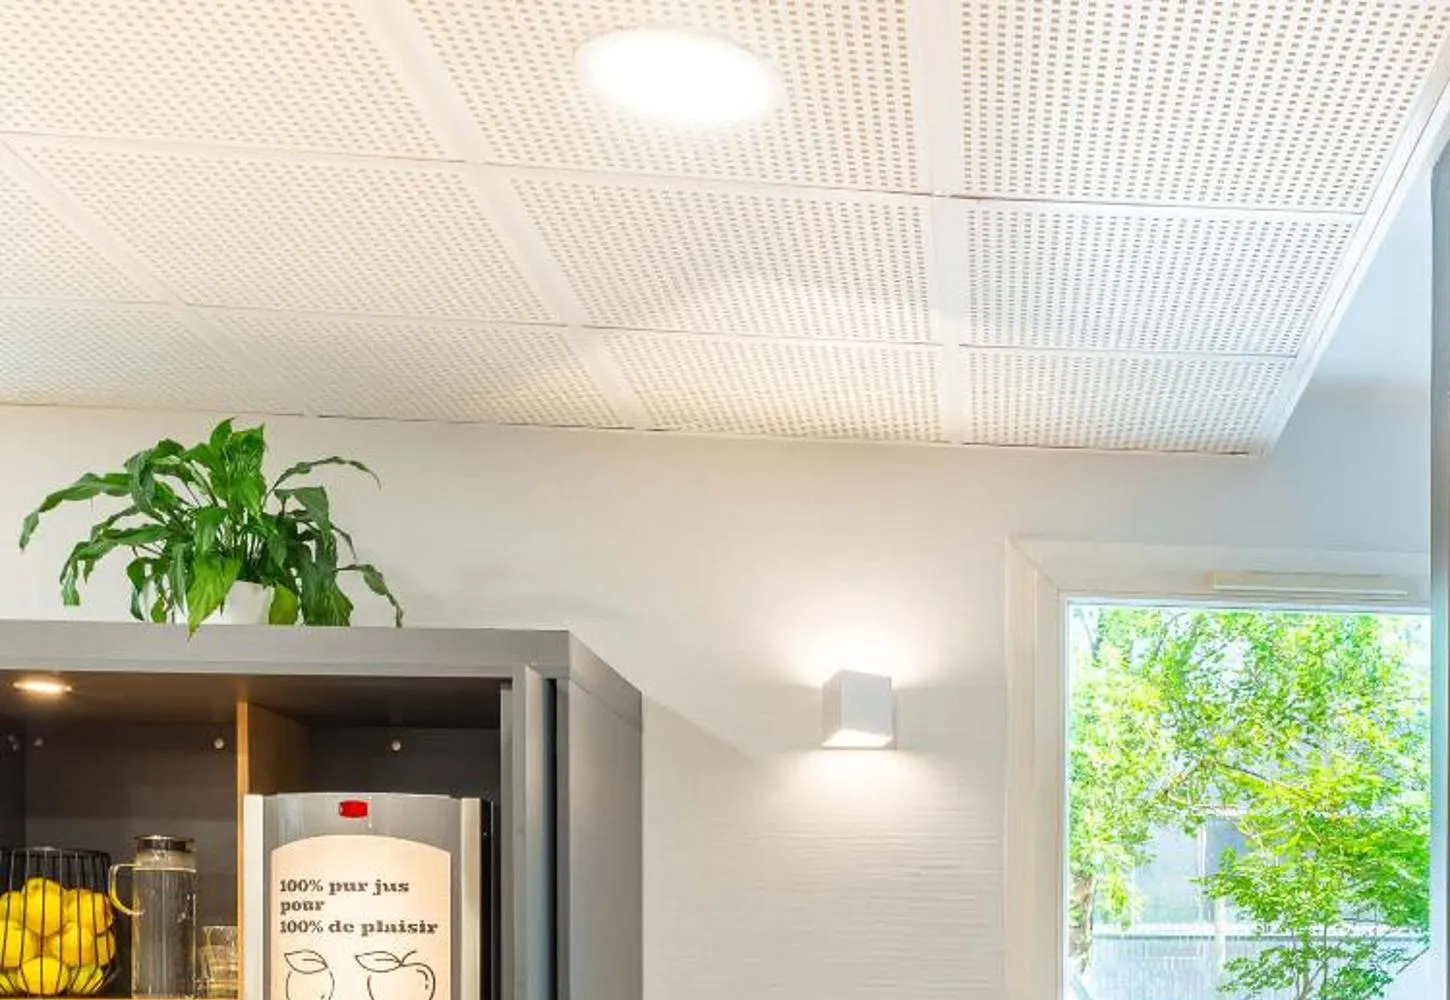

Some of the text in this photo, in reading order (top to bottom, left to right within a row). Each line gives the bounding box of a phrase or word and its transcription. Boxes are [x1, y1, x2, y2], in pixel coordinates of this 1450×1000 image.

[280, 879, 410, 896] 100% pur jus
[280, 900, 325, 916] pour
[280, 920, 439, 937] 100% de plaisir
